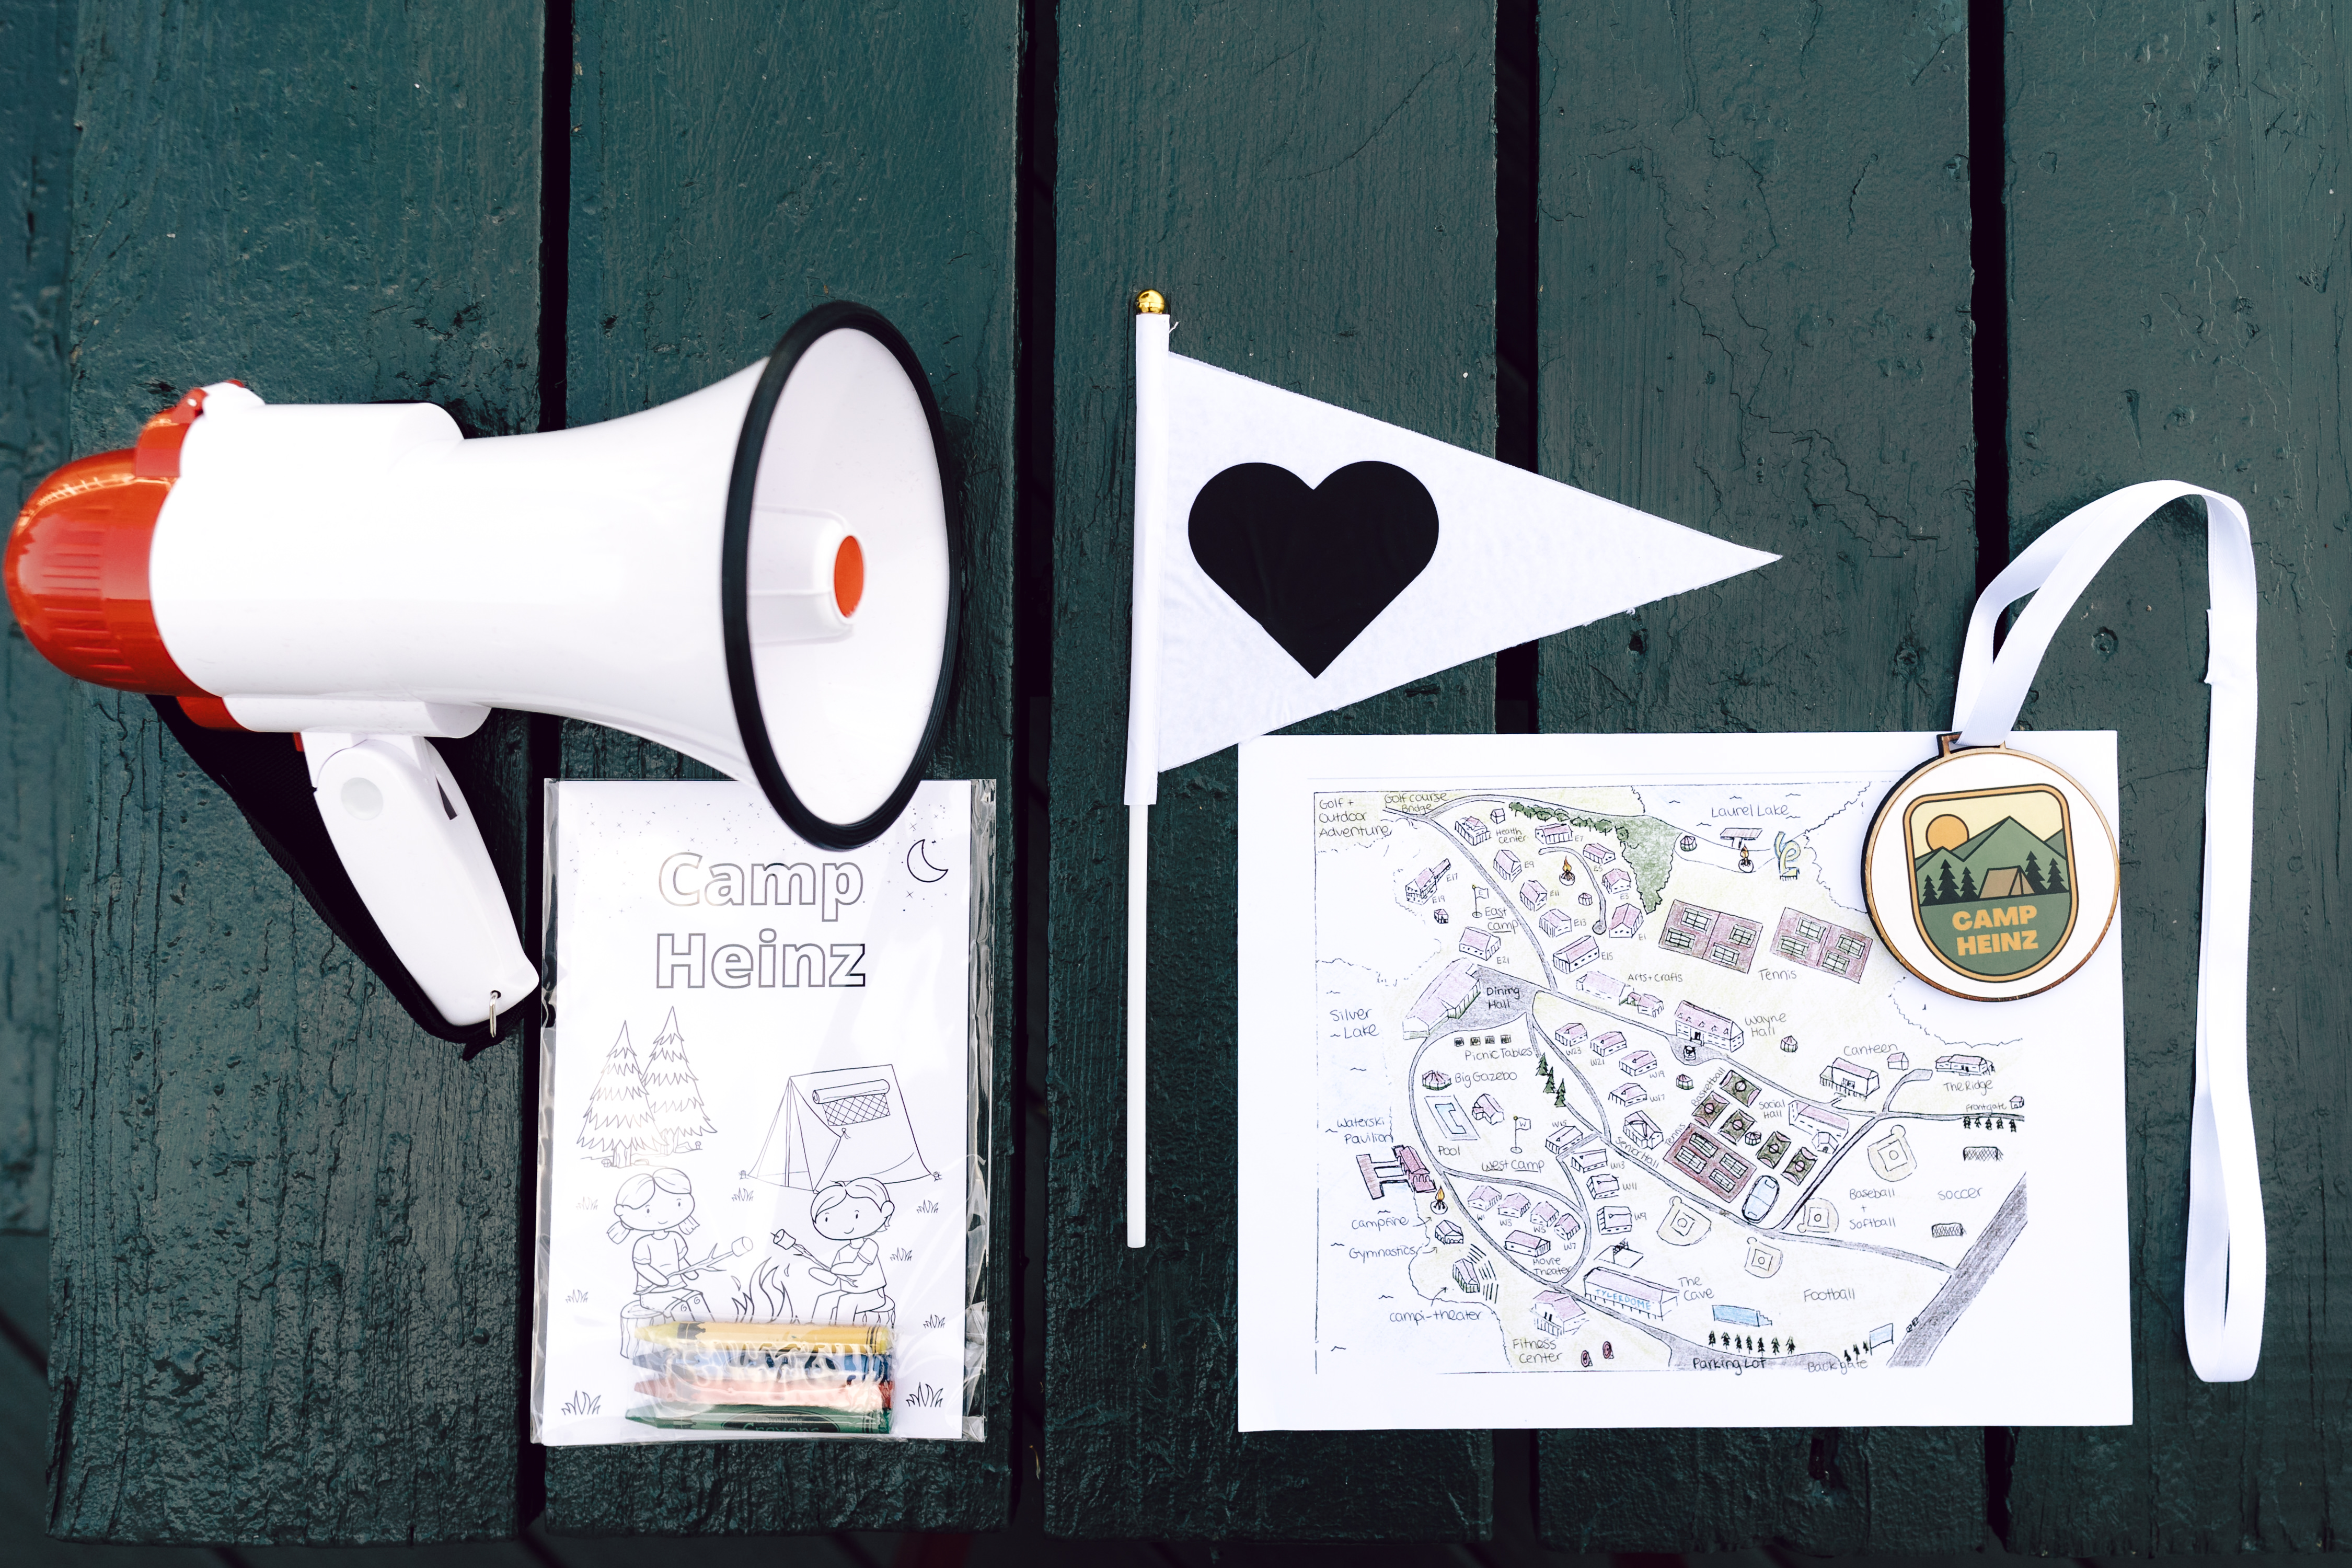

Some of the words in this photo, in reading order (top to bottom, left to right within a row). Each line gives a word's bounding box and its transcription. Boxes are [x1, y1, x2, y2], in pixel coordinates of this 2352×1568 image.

[1319, 798, 1344, 810] Golf
[1711, 804, 1753, 818] Laurel
[1757, 804, 1790, 816] Lake
[1319, 812, 1367, 823] Outdoor
[1319, 824, 1392, 837] Adventure
[1496, 828, 1522, 837] Health
[1446, 872, 1458, 882] E17
[659, 852, 863, 923] Camp
[1432, 895, 1446, 904] E19
[1485, 906, 1507, 917] East
[1574, 918, 1587, 927] E13
[1952, 905, 2037, 931] CAMP
[1957, 930, 2038, 956] HEINZ
[656, 928, 866, 989] Heinz
[1601, 951, 1613, 961] E15
[1758, 967, 1797, 981] Tennis
[1486, 987, 1520, 999] Dining
[1489, 1000, 1511, 1009] Hall
[1329, 1008, 1373, 1022] Silver
[1745, 1012, 1787, 1028] Wayne
[1344, 1023, 1380, 1039] Lake
[1751, 1027, 1776, 1037] Hall
[1565, 1046, 1582, 1056] W23
[1690, 1067, 1726, 1106] Basketball
[1763, 1110, 1782, 1119] Hall
[1344, 1133, 1393, 1145] Pavilion
[1664, 1123, 1686, 1147] Tennis
[1610, 1161, 1625, 1169] W13
[1641, 1152, 1659, 1169] Hall
[1622, 1182, 1638, 1191] W11
[1849, 1188, 1895, 1200] Baseball
[1634, 1212, 1647, 1221] W9
[1849, 1216, 1896, 1230] Softball
[1534, 1226, 1546, 1234] W5
[1563, 1242, 1576, 1251] W7
[1349, 1244, 1415, 1264] Gymnastics
[1532, 1257, 1561, 1266] Movie
[1532, 1266, 1572, 1276] Theater
[1678, 1276, 1703, 1287] The
[1804, 1289, 1855, 1302] Football
[1512, 1338, 1557, 1350] Fitness
[1693, 1358, 1742, 1375] Parking
[1745, 1358, 1767, 1369] Lot
[1807, 1361, 1837, 1373] Back
